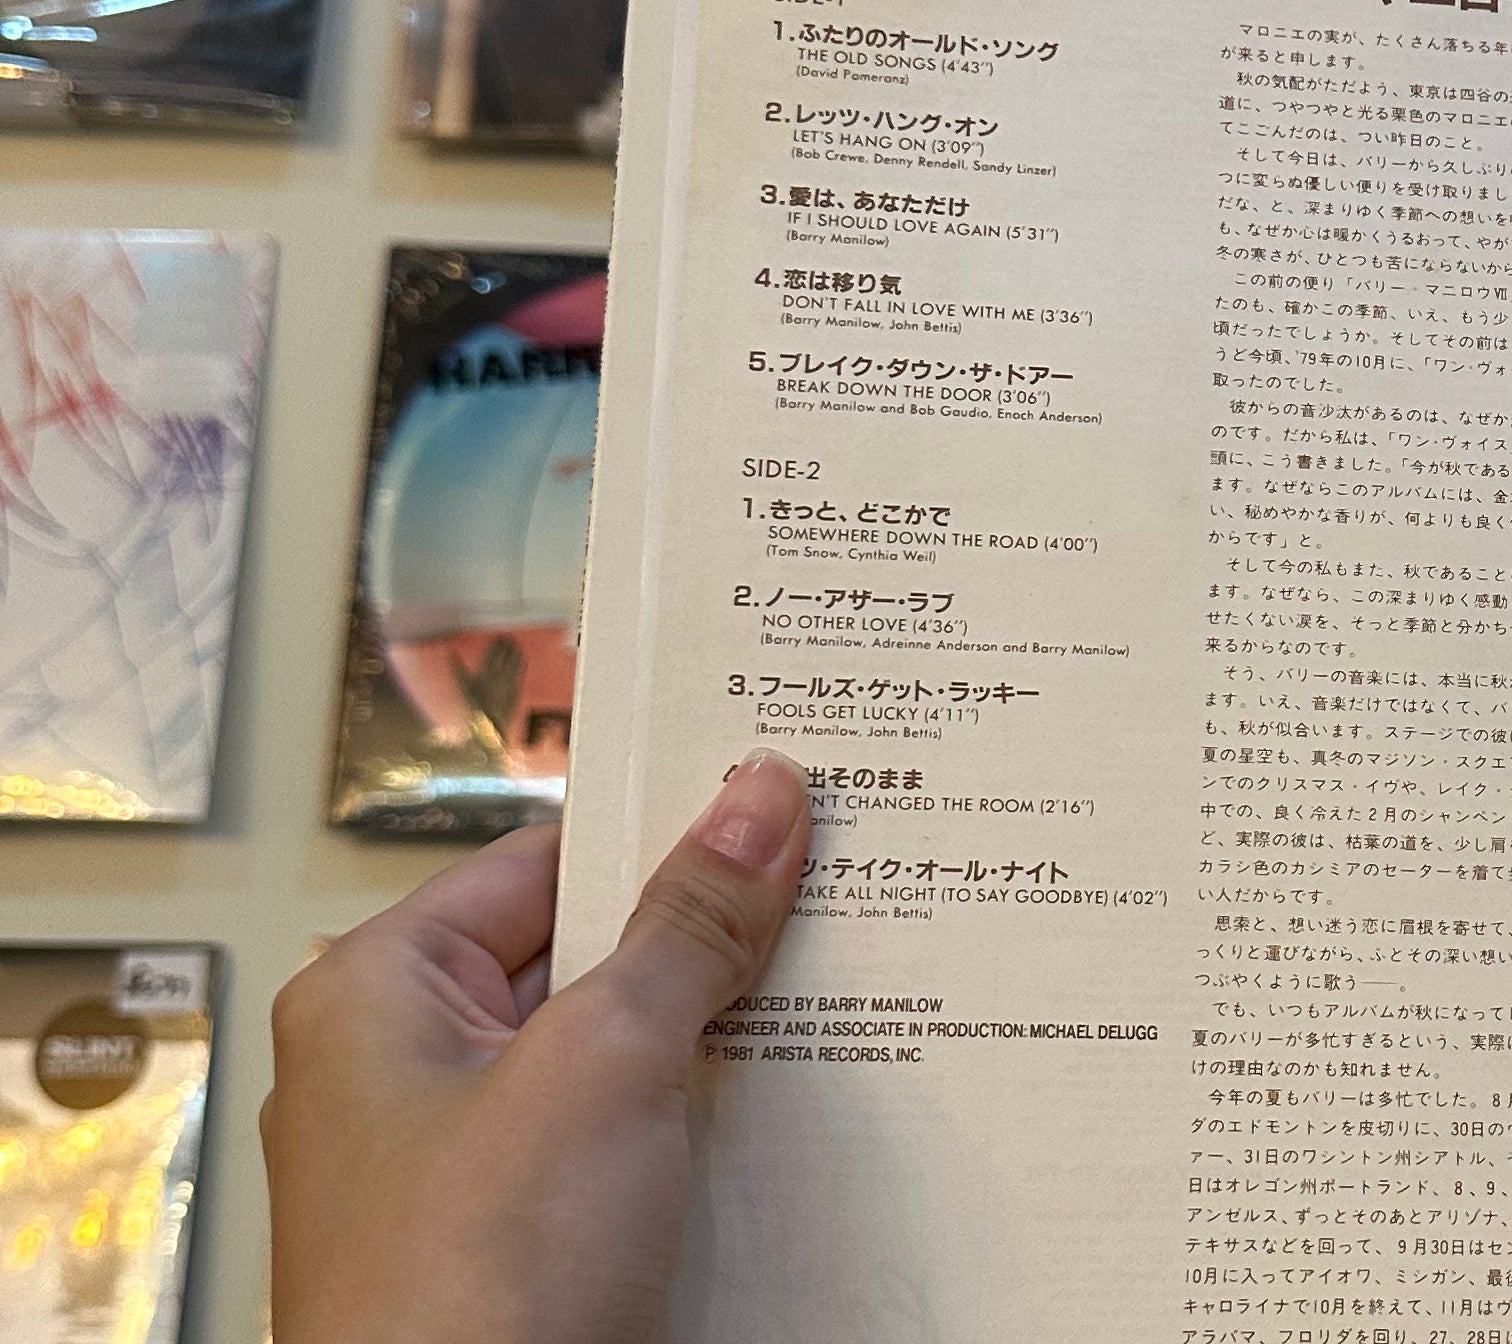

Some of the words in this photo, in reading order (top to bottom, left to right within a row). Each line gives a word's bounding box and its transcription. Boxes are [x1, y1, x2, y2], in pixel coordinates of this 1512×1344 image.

[773, 19, 1059, 62] 1.ふたりのオールド・ソング
[797, 46, 828, 63] THE
[833, 50, 868, 66] OLD
[874, 53, 936, 71] SONGS
[1220, 46, 1364, 70] が来ると申します。
[764, 101, 999, 137] 2.レッツ・ハング・オン
[792, 128, 834, 145] LET'S
[839, 133, 893, 149] HANG
[898, 136, 926, 152] ON
[759, 183, 970, 218] 3.愛は、あなただけ
[787, 211, 801, 224] IF
[807, 212, 812, 225] I
[816, 212, 888, 231] SHOULD
[894, 218, 938, 234] LOVE
[943, 222, 1001, 238] AGAIN
[753, 267, 902, 296] 4.恋は移り気
[782, 294, 838, 310] DON'T
[844, 297, 882, 313] FALL
[887, 300, 905, 314] IN
[911, 302, 956, 317] LOVE
[961, 304, 1005, 320] WITH
[1011, 308, 1035, 322] ME
[776, 378, 831, 394] BREAK
[837, 381, 897, 397] DOWN
[902, 384, 934, 399] THE
[940, 386, 992, 403] DOOR
[1212, 371, 1342, 394] 取ったのでした。
[741, 457, 821, 480] SIDE-2
[742, 497, 951, 527] 1.きっと、どこかで
[767, 525, 879, 544] SOMEWHERE
[886, 530, 946, 546] DOWN
[951, 532, 983, 548] THE
[988, 534, 1039, 549] ROAD
[733, 584, 955, 614] 2.ノー・アザー・ラブ
[762, 613, 792, 629] NO
[797, 614, 855, 630] OTHER
[861, 617, 907, 632] LOVE
[757, 702, 817, 719] FOOLS
[822, 704, 857, 719] GET
[862, 705, 919, 721] LUCKY
[845, 795, 935, 811] CHANGED
[941, 796, 973, 812] THE
[979, 797, 1035, 813] ROOM
[797, 884, 838, 900] TAKE
[844, 885, 873, 900] ALL
[879, 886, 937, 902] NIGHT
[941, 887, 971, 903] (TO
[976, 887, 1009, 903] SAY
[1014, 888, 1108, 907] GOODBYE)
[724, 996, 790, 1012] ODUCED
[794, 996, 814, 1011] BY
[817, 996, 868, 1012] BARRY
[871, 997, 944, 1013] MANILOW
[783, 1021, 817, 1036] AND
[820, 1021, 905, 1037] ASSOCIATE
[908, 1022, 923, 1037] IN
[1097, 1024, 1158, 1041] DELUGG
[722, 1046, 753, 1061] 1981
[761, 1045, 813, 1061] ARISTA
[818, 1046, 894, 1064] RECORDS,
[895, 1046, 924, 1063] INC.
